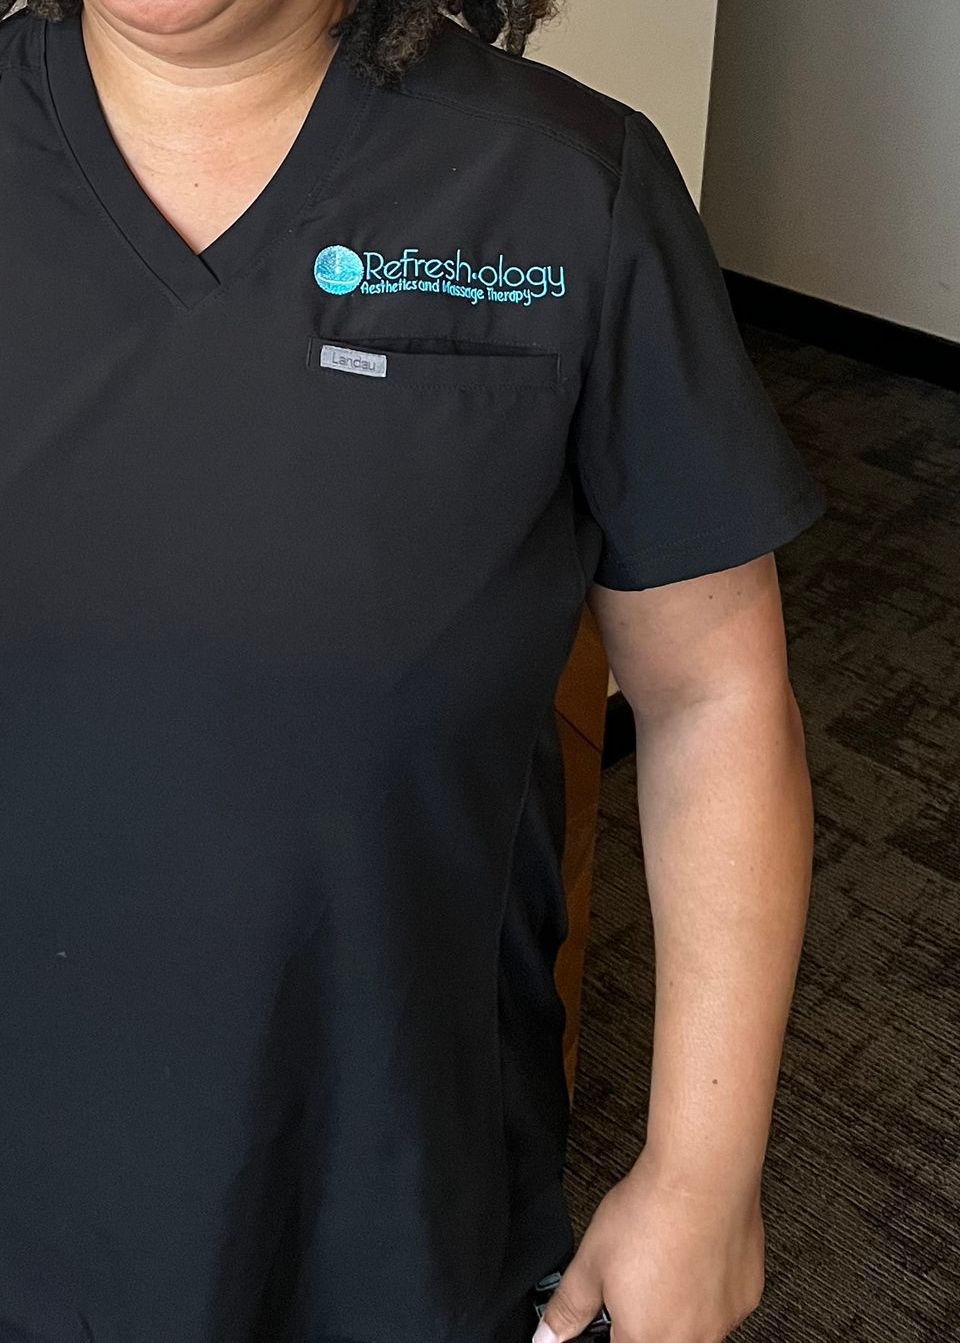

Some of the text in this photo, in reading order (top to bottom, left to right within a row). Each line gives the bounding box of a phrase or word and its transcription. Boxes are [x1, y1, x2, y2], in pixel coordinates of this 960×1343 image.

[360, 278, 532, 306] Aesthetics and Massage Therapy
[331, 351, 376, 371] Landau
